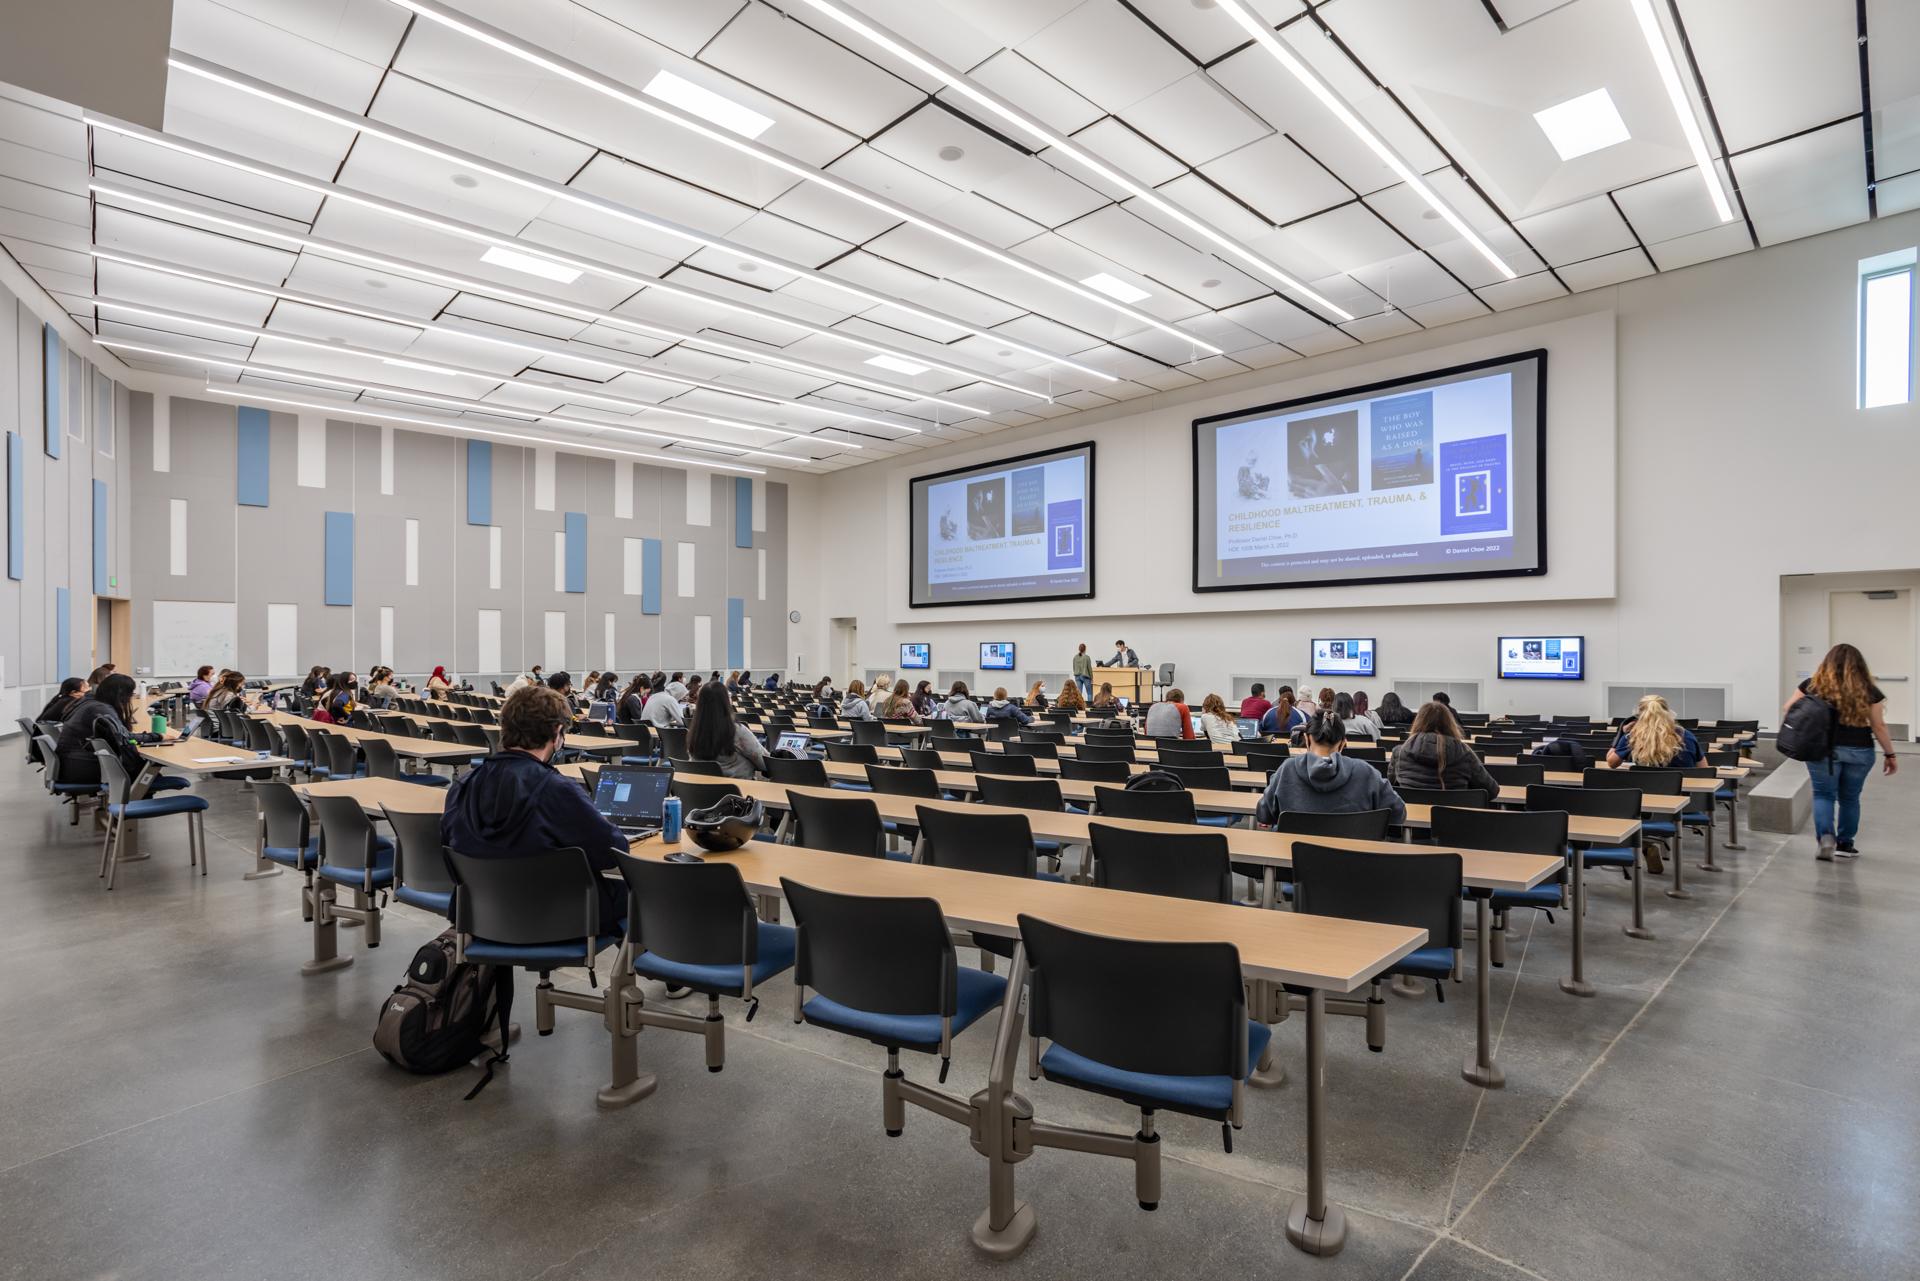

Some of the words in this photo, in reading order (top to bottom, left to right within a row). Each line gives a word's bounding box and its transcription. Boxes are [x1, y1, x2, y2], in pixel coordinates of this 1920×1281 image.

[1404, 410, 1421, 419] BOY
[1403, 439, 1423, 447] DOG
[1229, 509, 1281, 521] CHILDHOOD
[1420, 492, 1427, 500] &
[1229, 521, 1280, 532] RESILIENCE
